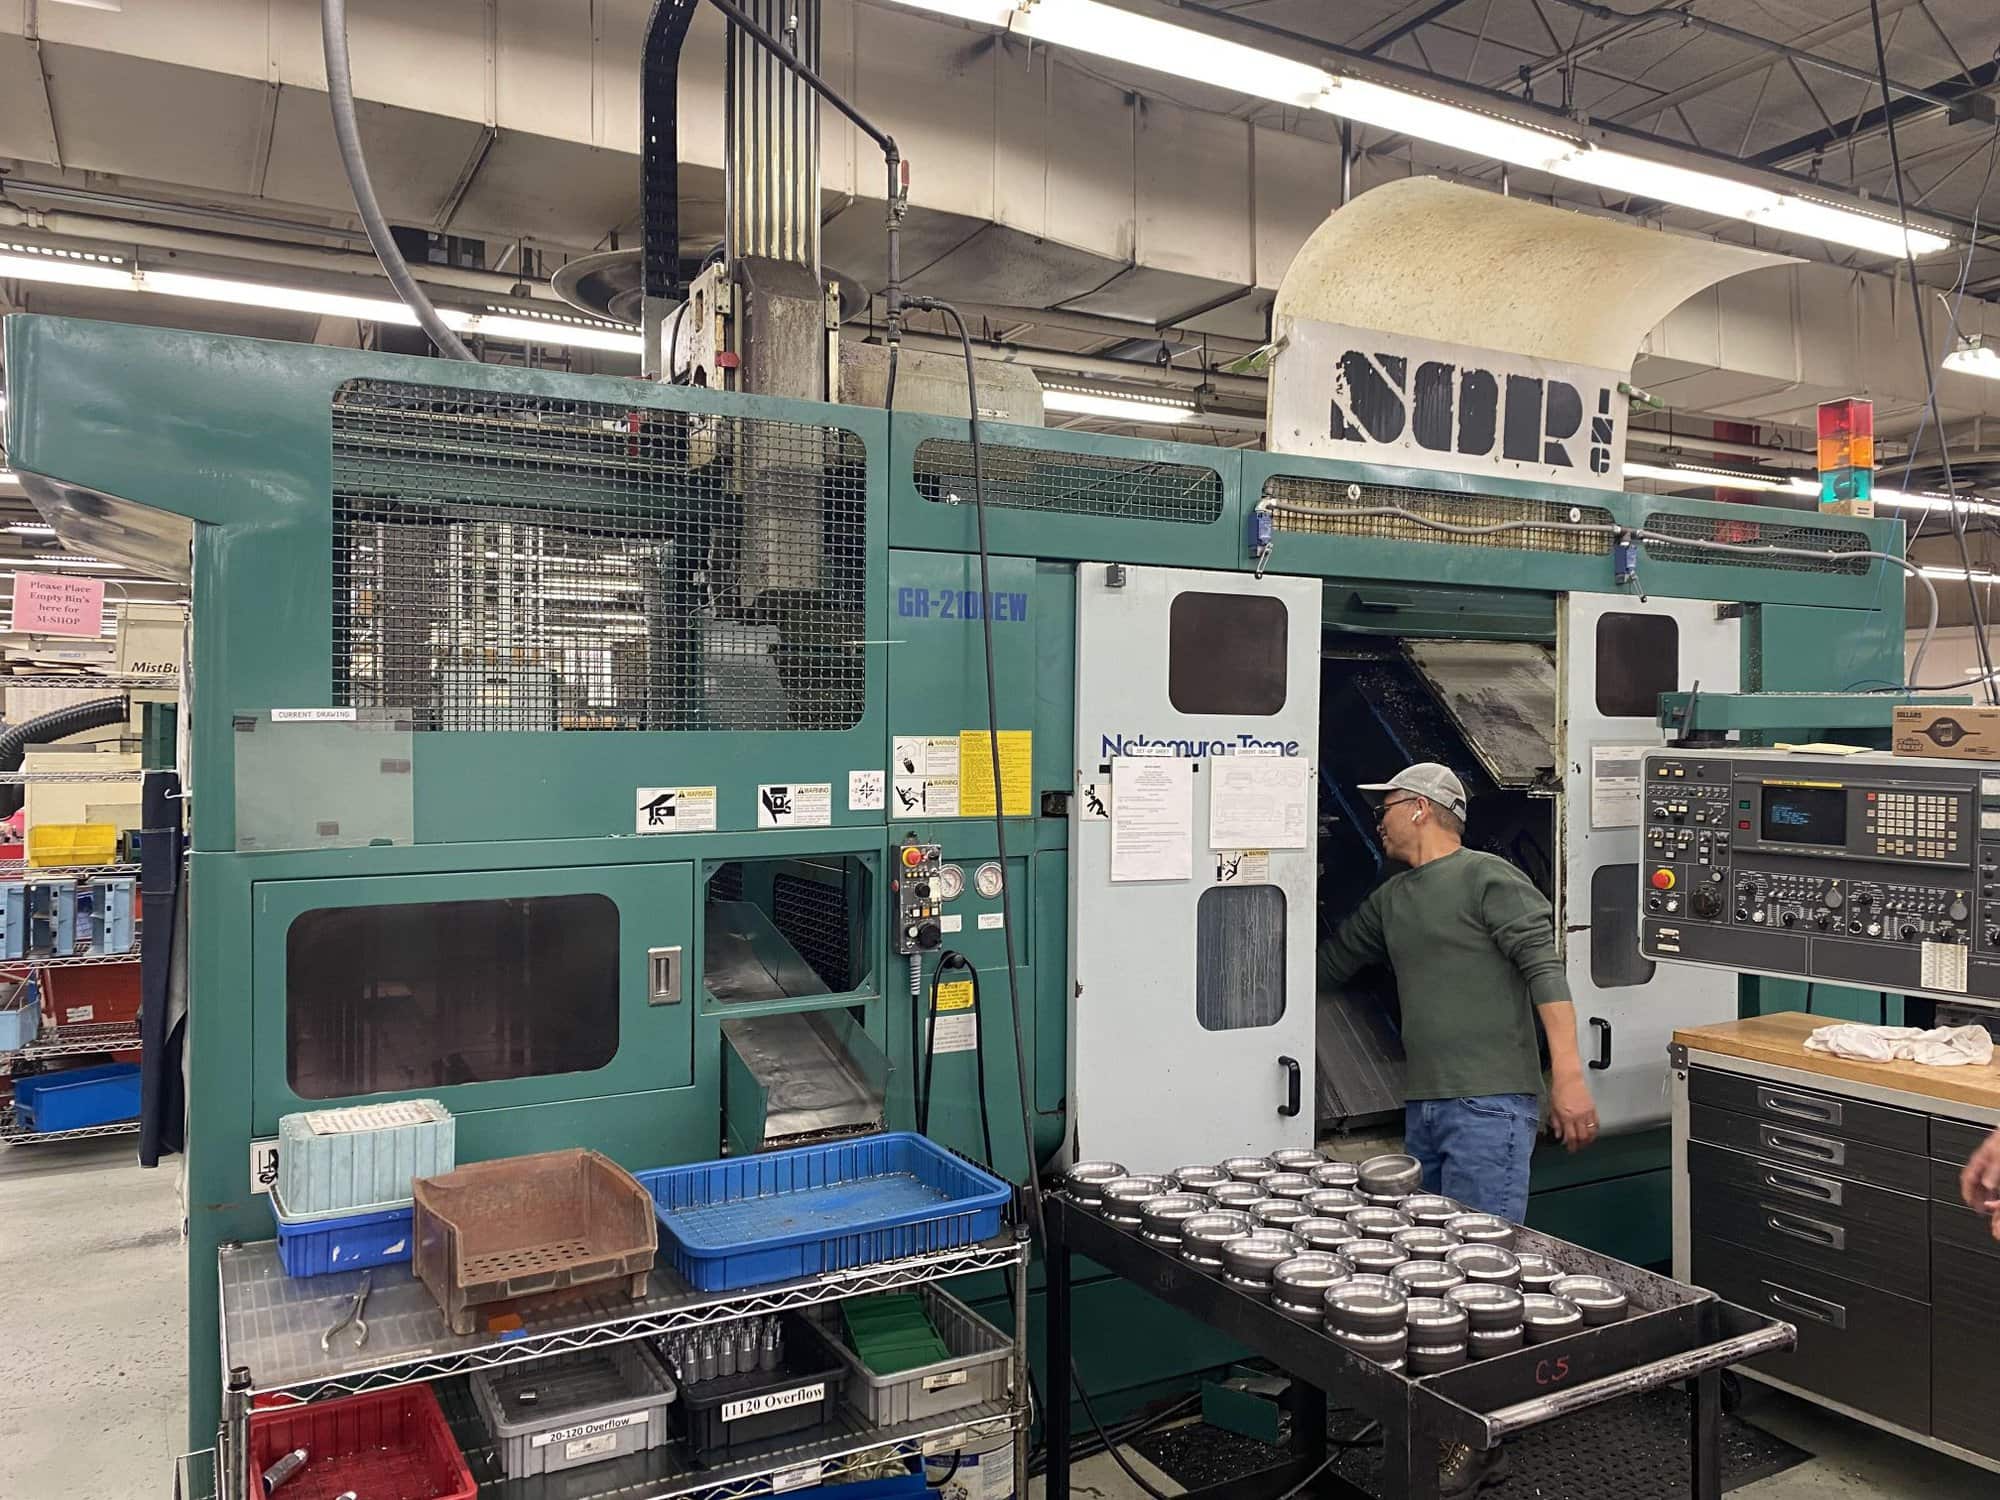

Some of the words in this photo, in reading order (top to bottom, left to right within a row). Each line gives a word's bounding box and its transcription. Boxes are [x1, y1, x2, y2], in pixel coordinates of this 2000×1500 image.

[1329, 349, 1584, 469] SOR
[1589, 387, 1614, 475] INC
[30, 581, 62, 591] Please
[65, 584, 93, 593] Place
[30, 592, 62, 603] Empty
[65, 594, 91, 603] Bin's
[39, 604, 62, 612] here
[64, 605, 80, 613] for
[37, 616, 81, 625] M-SHOP
[278, 711, 312, 719] CURRENT
[316, 711, 350, 719] DRAWING
[1535, 1354, 1569, 1385] C5
[764, 1387, 823, 1408] Overflow
[550, 1428, 583, 1442] 20-120
[585, 1417, 630, 1434] Overflow
